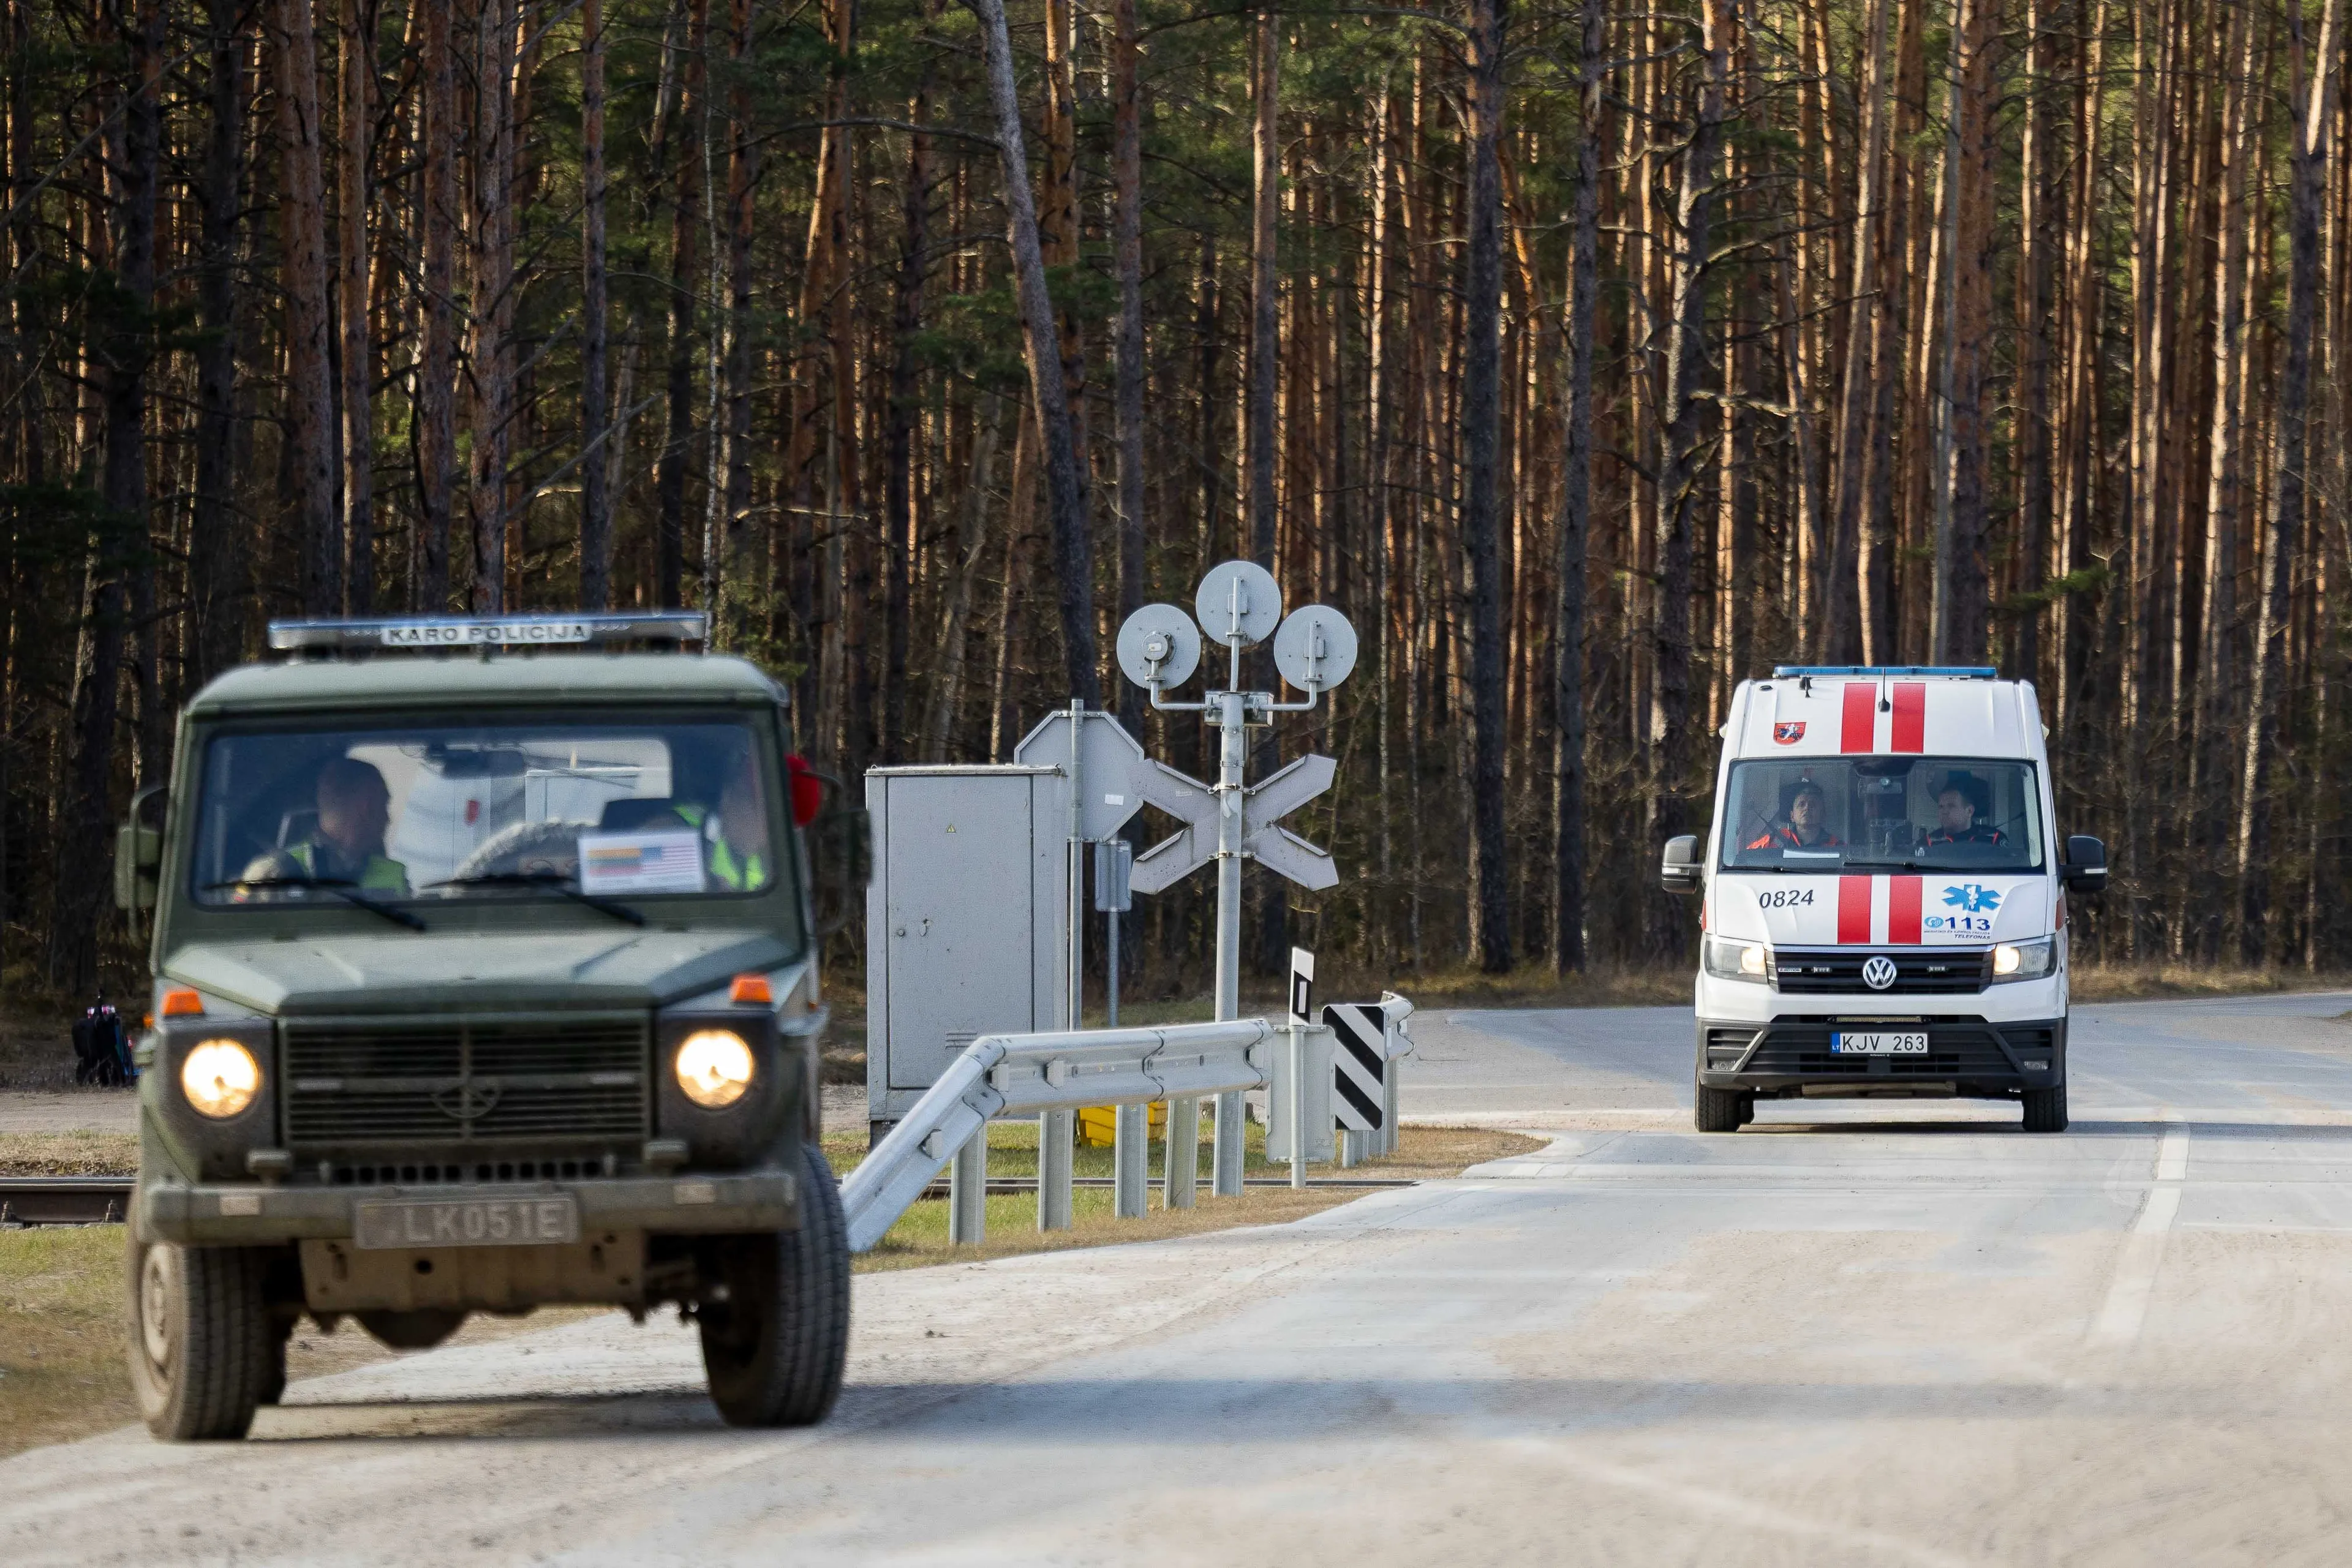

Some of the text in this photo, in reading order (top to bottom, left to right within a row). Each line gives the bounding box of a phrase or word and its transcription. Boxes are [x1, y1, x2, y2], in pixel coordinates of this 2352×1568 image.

[388, 625, 586, 643] KARO POLICIJA
[1759, 889, 1814, 909] 0824
[1945, 916, 1990, 931] 113
[1842, 1036, 1880, 1051] KJV
[1893, 1036, 1924, 1051] 263
[404, 1202, 565, 1242] LK051E
